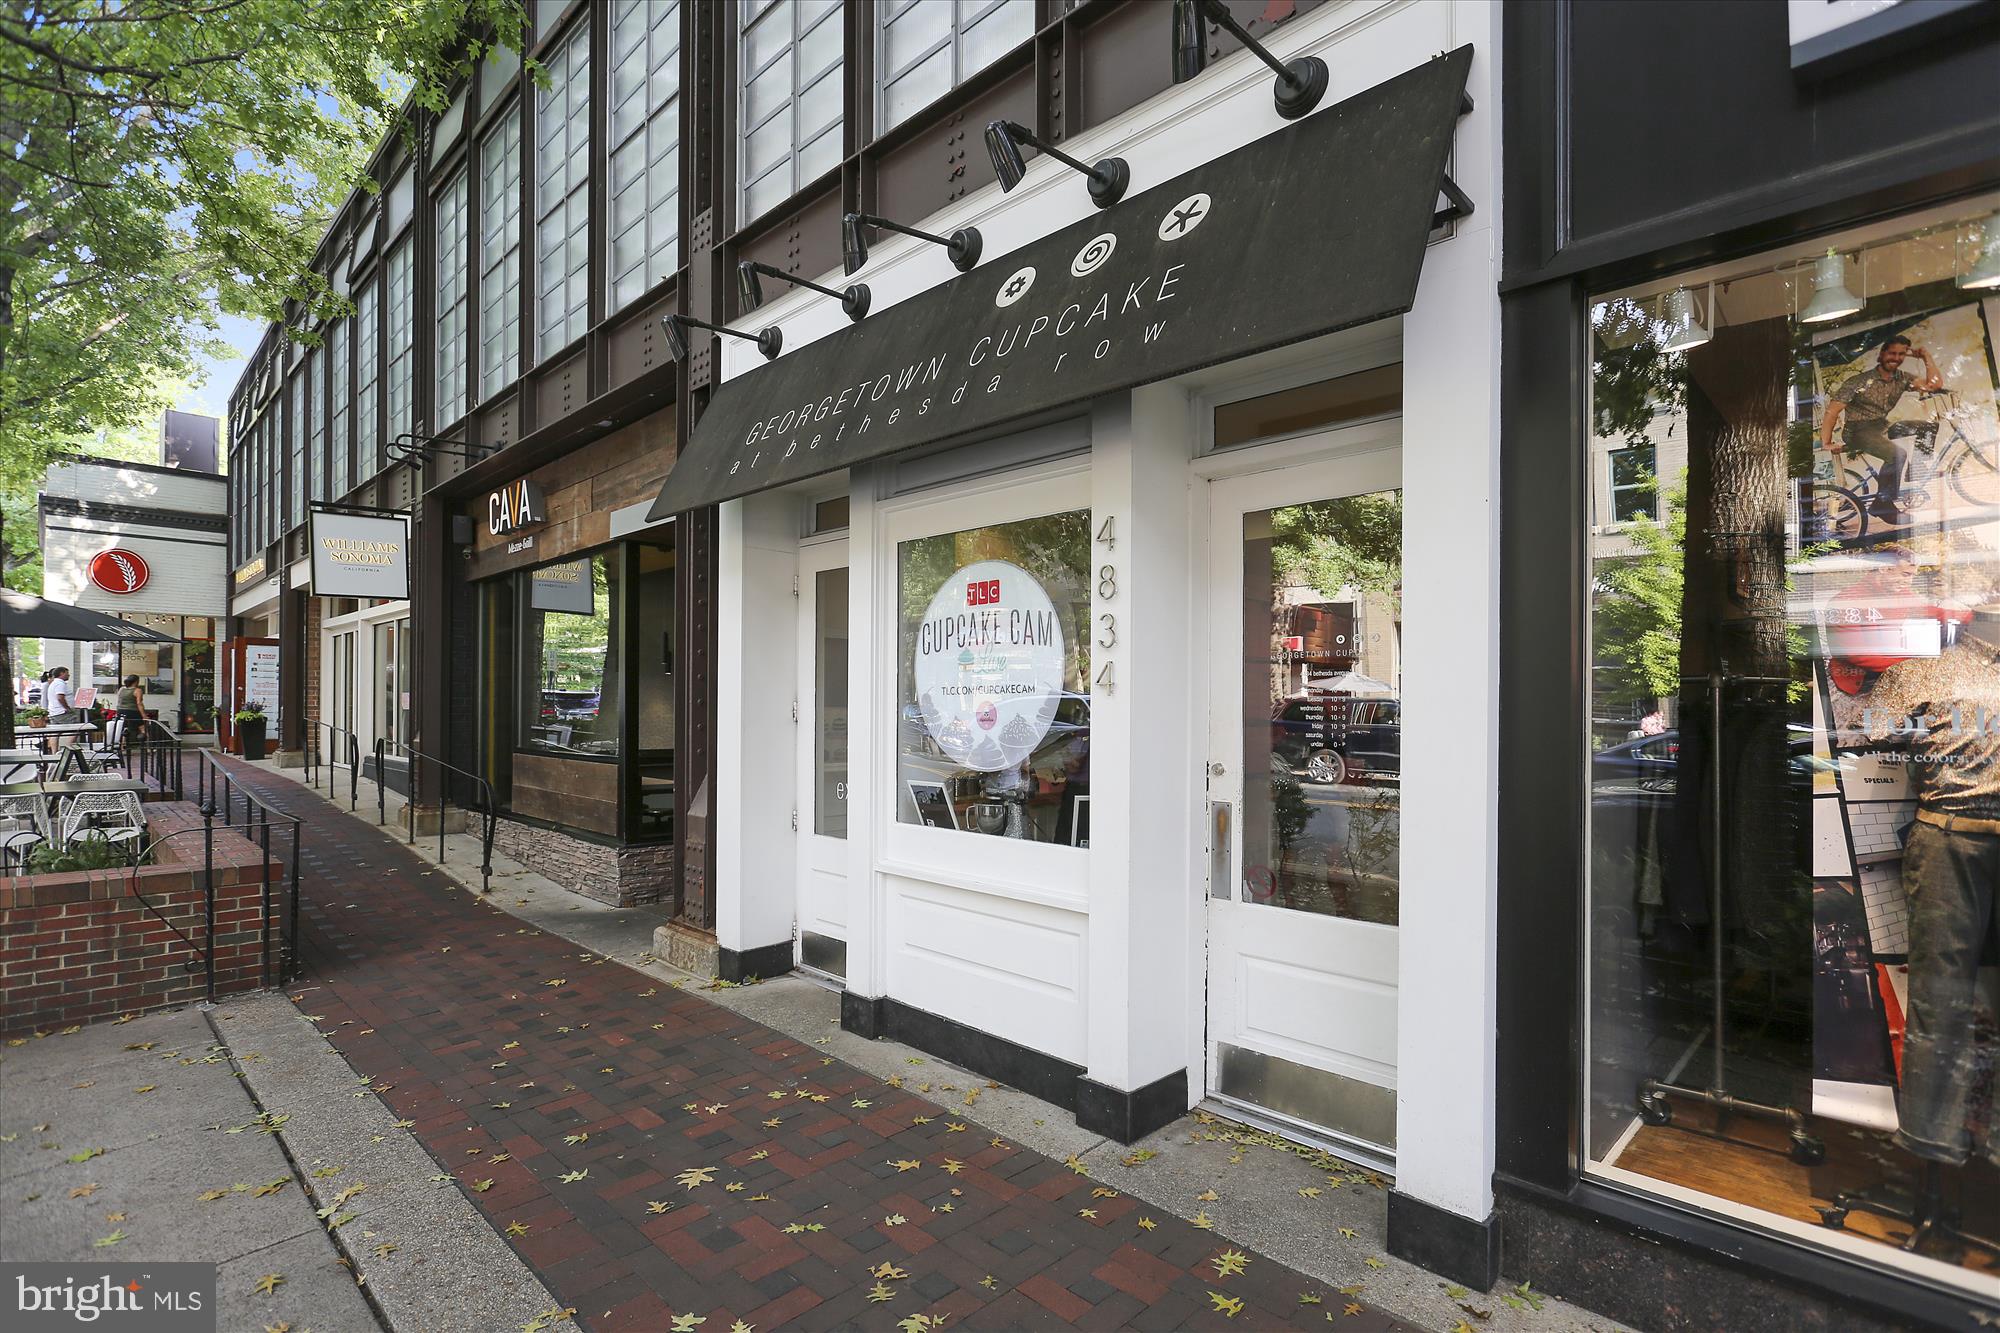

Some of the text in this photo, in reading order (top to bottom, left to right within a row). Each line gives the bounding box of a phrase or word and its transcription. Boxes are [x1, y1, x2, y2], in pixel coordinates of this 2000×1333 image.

[745, 263, 1186, 446] GEORGETOWN CUPCAKE
[729, 321, 1167, 475] at bethesda row
[489, 479, 532, 536] CAVA
[321, 536, 400, 553] WILLIAMS
[330, 551, 393, 566] SONOMA
[967, 582, 999, 604] TLC
[1096, 515, 1117, 696] 4834
[922, 608, 1053, 655] CUPCAKE CAM
[941, 684, 1036, 696] TLC.COM/CUPCAKECAM
[1881, 751, 1911, 763] the
[1864, 777, 1895, 785] SPECIALS
